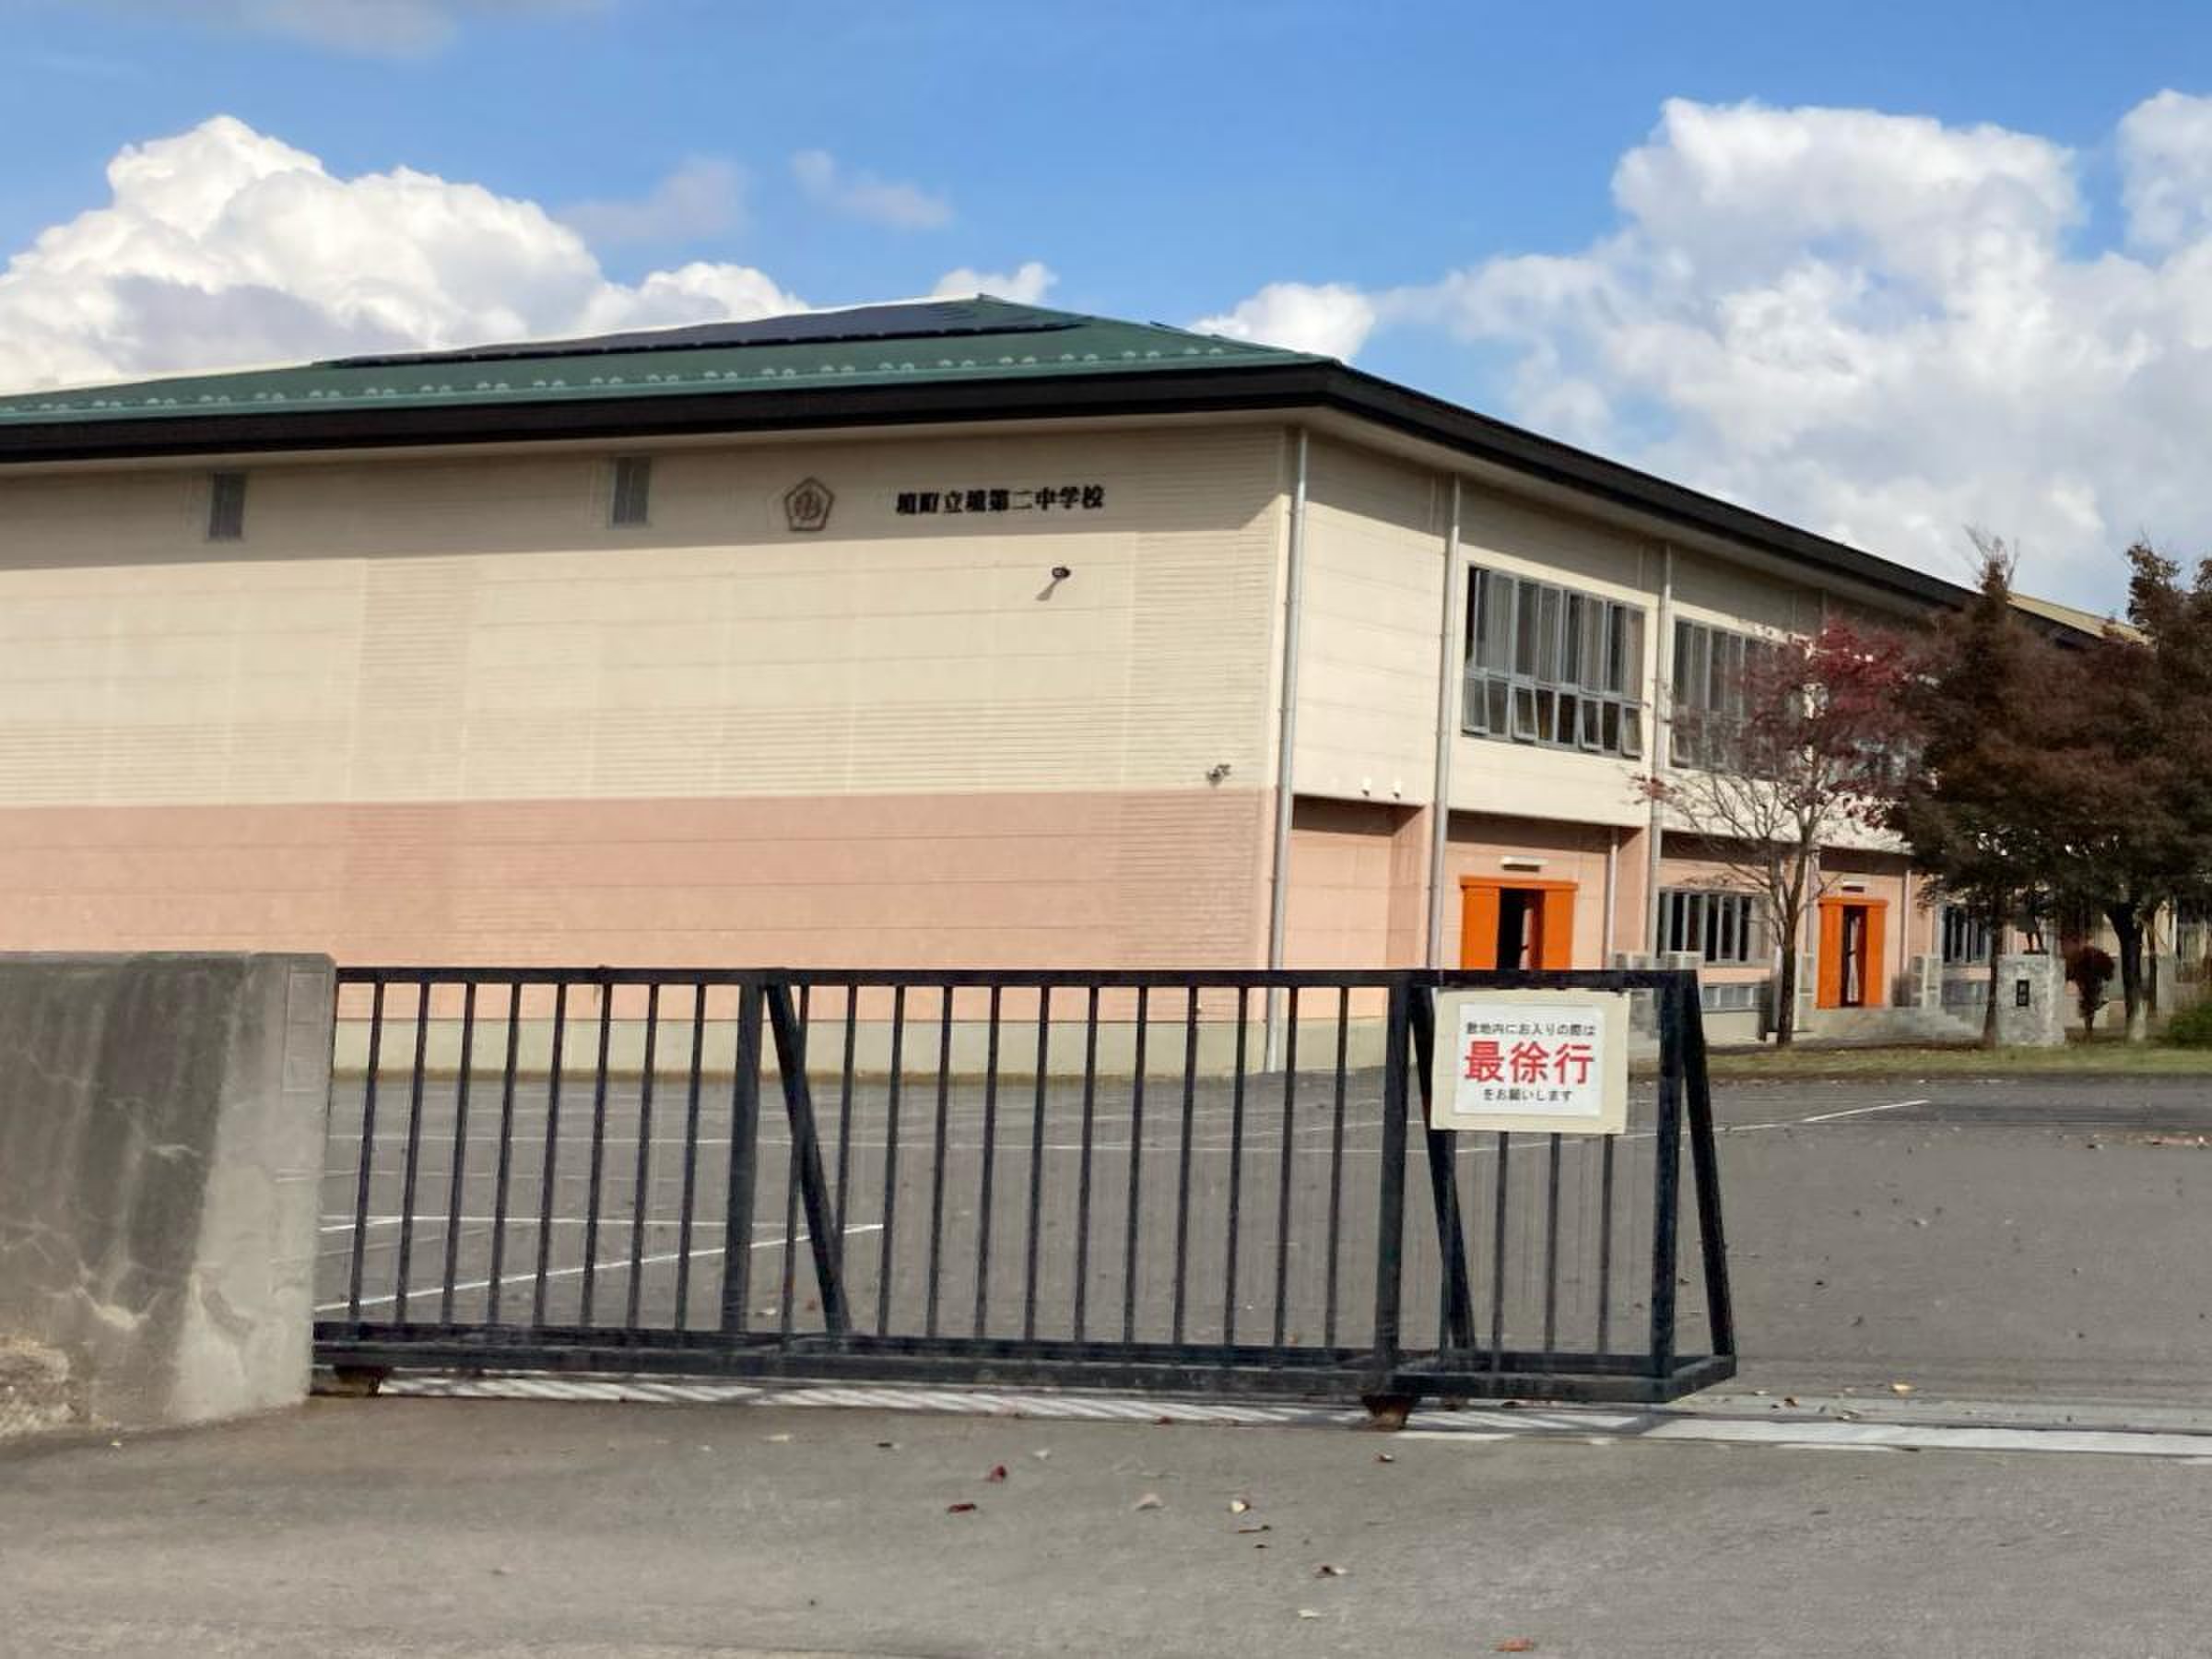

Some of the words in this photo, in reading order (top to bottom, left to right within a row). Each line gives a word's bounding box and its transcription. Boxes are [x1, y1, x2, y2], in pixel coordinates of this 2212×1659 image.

[1465, 1041, 1594, 1084] 最徐行
[1483, 1088, 1572, 1101] をお願いします
